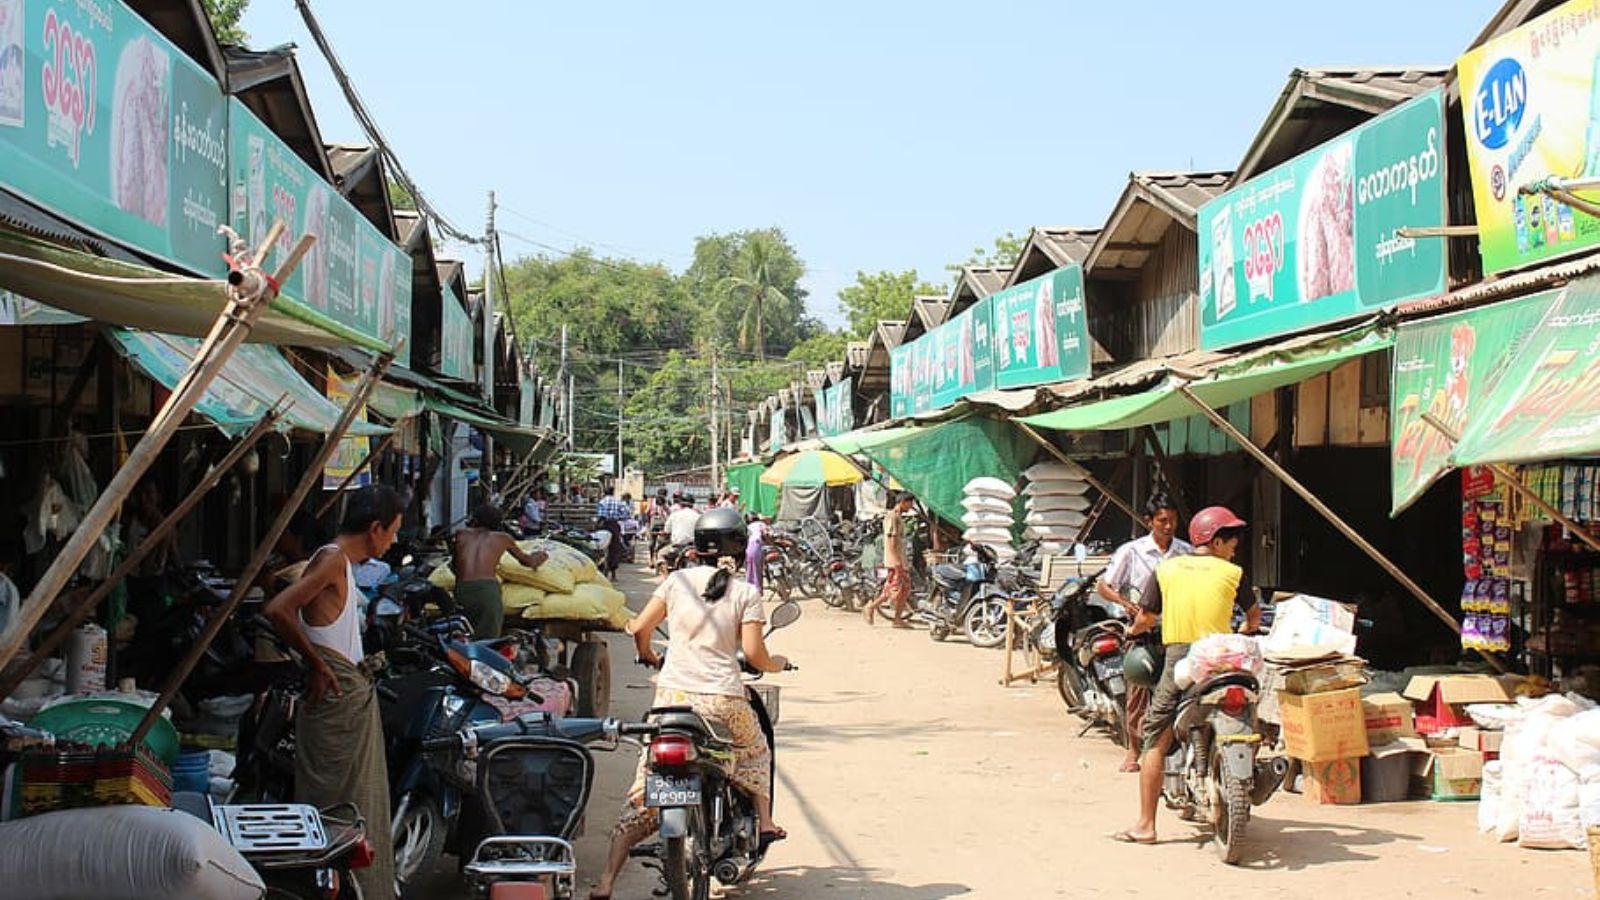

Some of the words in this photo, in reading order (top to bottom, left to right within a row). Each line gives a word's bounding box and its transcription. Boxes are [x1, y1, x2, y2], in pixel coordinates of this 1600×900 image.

[1476, 69, 1526, 141] E-LAN
[1357, 126, 1439, 207] လောကနတ်
